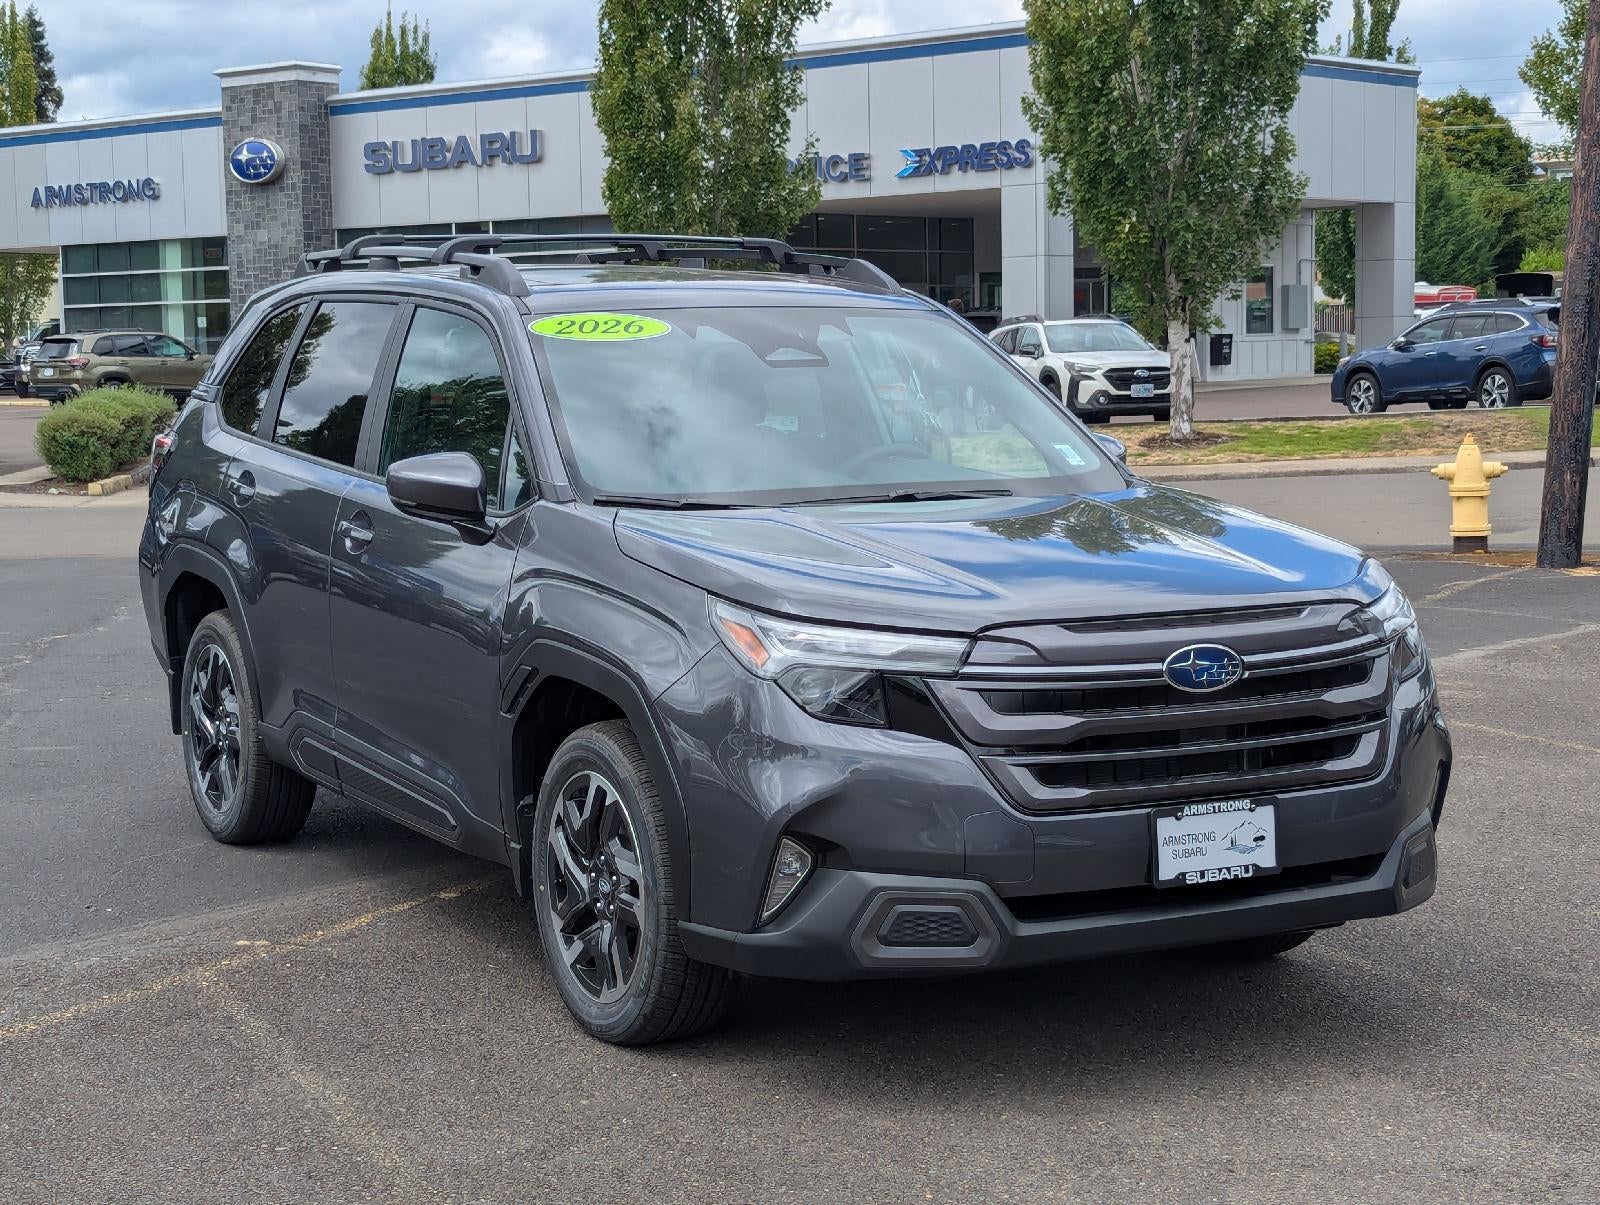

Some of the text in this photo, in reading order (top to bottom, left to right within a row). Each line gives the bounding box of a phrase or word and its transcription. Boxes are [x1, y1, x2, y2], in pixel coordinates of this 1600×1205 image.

[364, 130, 543, 174] SUBARU
[896, 139, 1033, 178] EXPRESS
[31, 177, 160, 208] ARMSTRONG
[555, 319, 645, 334] 2026
[1182, 800, 1251, 816] ARMSTRONG
[1162, 831, 1216, 847] ARMSTRONG
[1172, 847, 1208, 860] SUBARU
[1185, 865, 1253, 885] SUBARU
